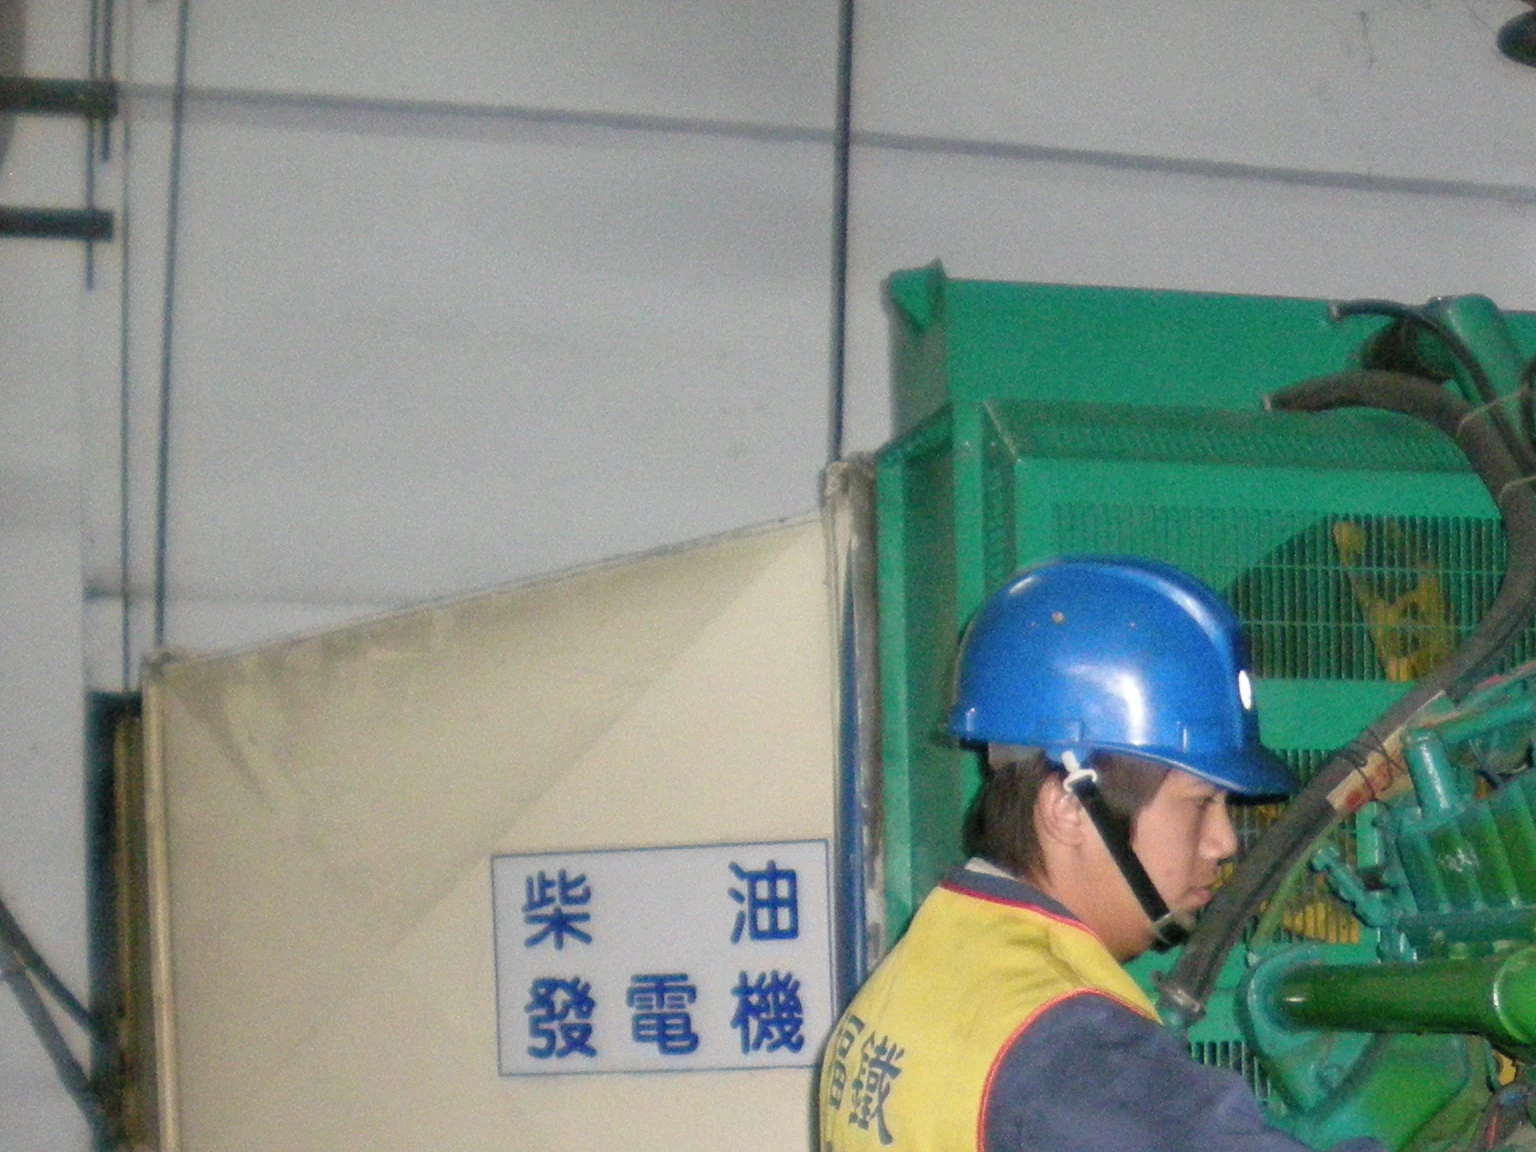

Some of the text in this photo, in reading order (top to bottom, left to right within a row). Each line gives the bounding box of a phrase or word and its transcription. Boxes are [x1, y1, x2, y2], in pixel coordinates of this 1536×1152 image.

[522, 860, 800, 950] 柴油
[524, 970, 805, 1059] 發電機
